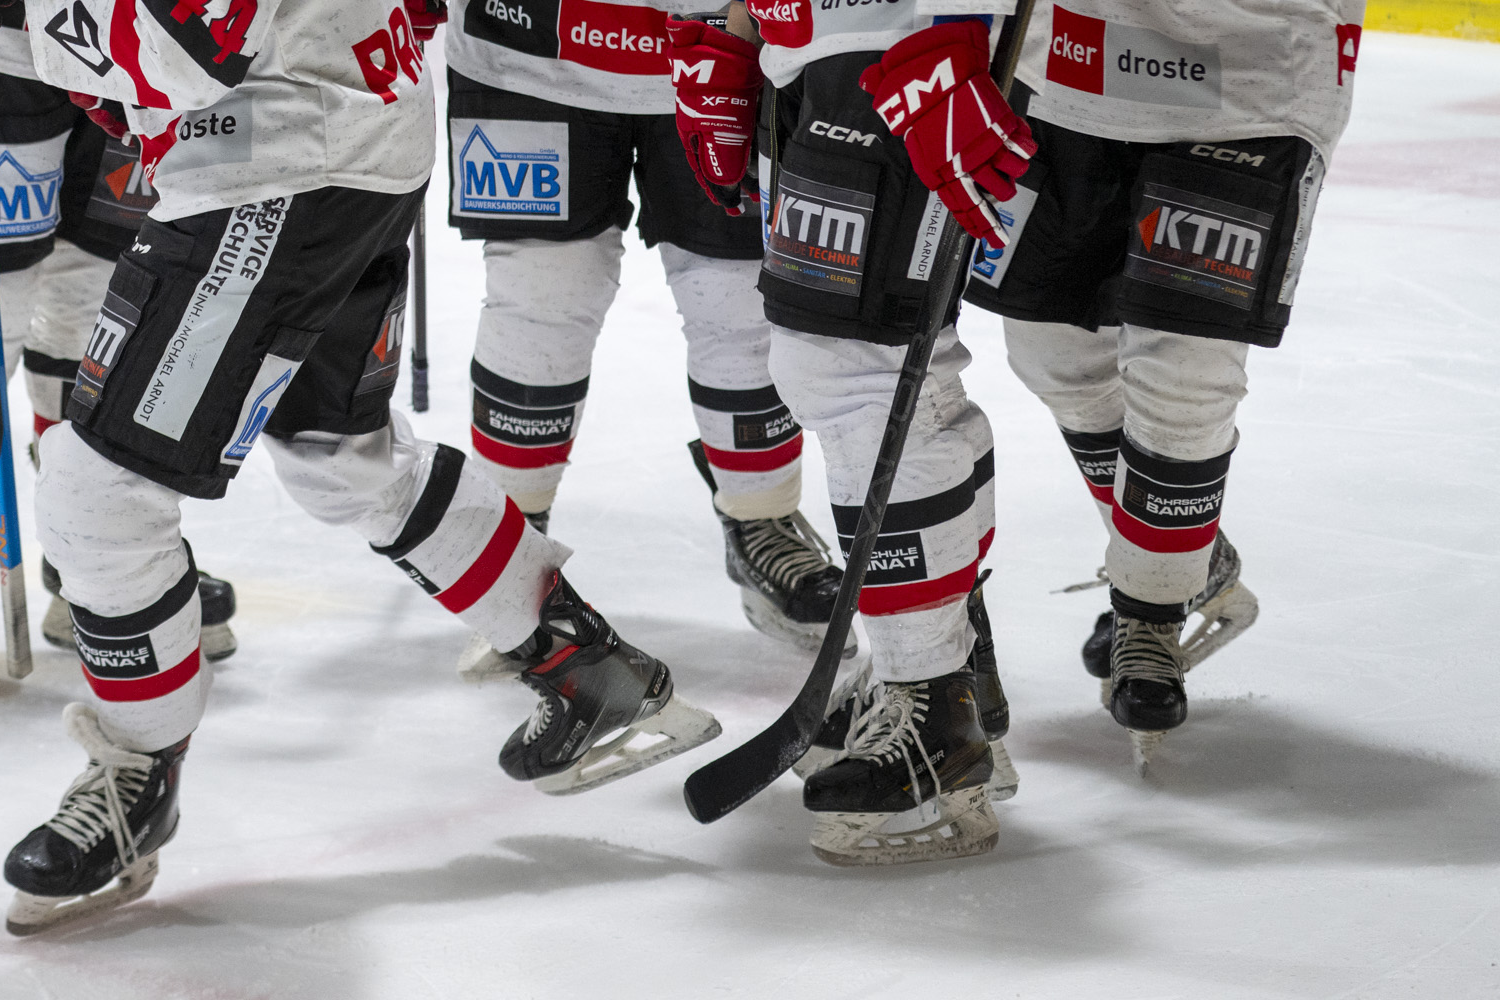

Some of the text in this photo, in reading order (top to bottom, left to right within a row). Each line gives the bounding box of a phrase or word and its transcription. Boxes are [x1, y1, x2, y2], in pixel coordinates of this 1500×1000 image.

[571, 22, 666, 54] decker
[1050, 33, 1206, 82] cker droste
[701, 96, 728, 106] XF
[180, 113, 236, 140] oste
[809, 120, 877, 147] CCM
[705, 142, 722, 177] CCM
[1190, 144, 1265, 168] CCM
[466, 160, 561, 199] MVB
[464, 200, 556, 211] BAUWERKSABDICHTUNG
[775, 193, 865, 255] KTM
[1153, 206, 1262, 270] KTM
[808, 246, 860, 267] TECHNIK
[916, 238, 934, 279] ARNDT
[1204, 258, 1253, 281] TECHNIK
[830, 274, 856, 285] ELEKTRO
[159, 325, 192, 379] MICHAEL
[138, 378, 163, 422] ARNDT
[489, 409, 572, 428] FAHRSCHULE
[489, 419, 571, 436] BANNAT
[1146, 498, 1222, 515] BANNAT
[1147, 489, 1223, 506] FAHRSCHULE
